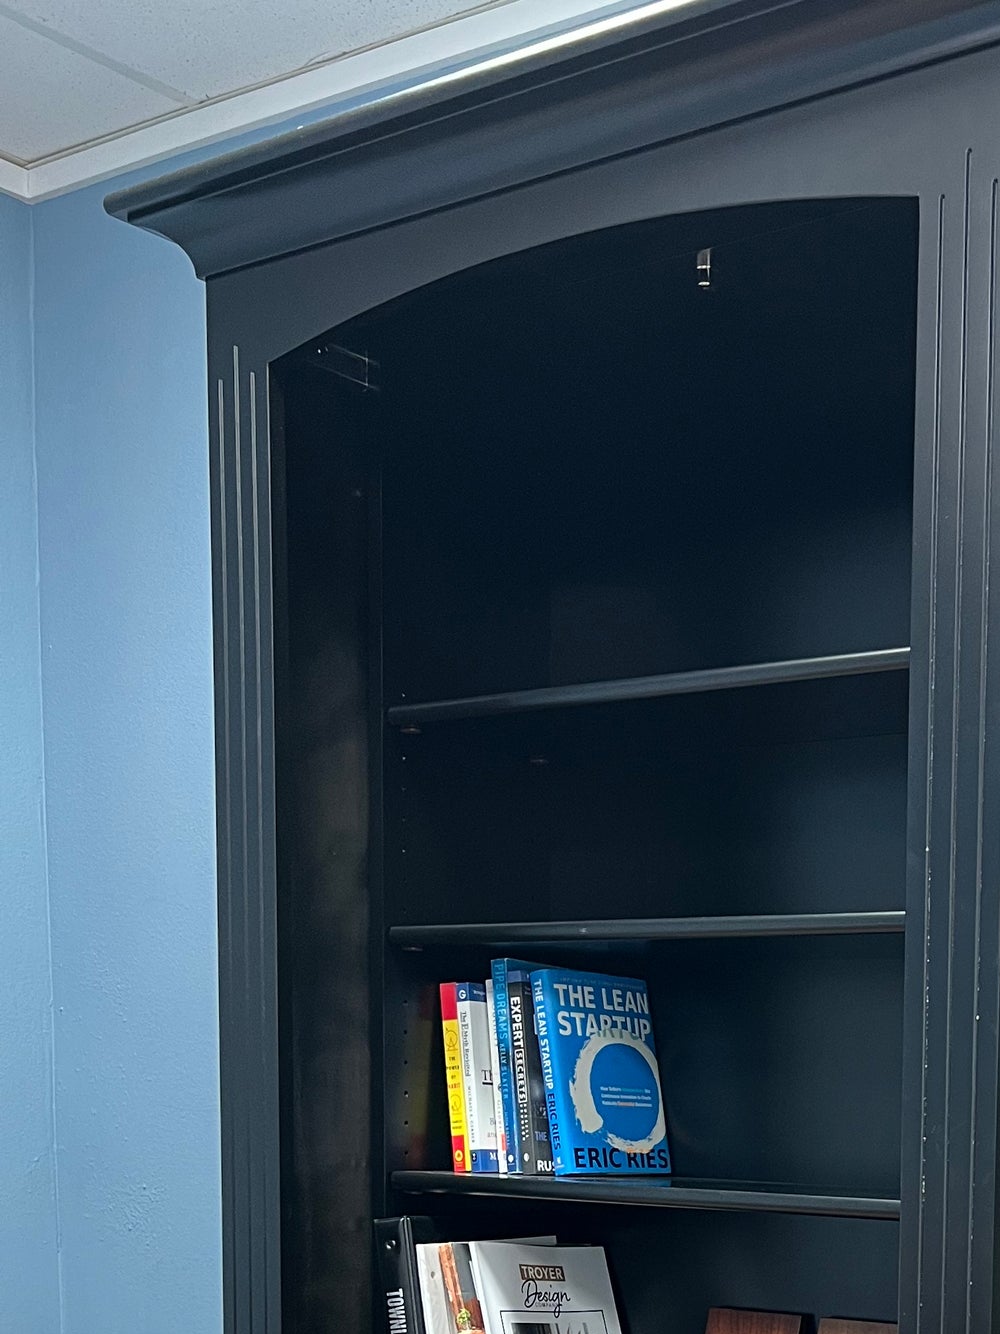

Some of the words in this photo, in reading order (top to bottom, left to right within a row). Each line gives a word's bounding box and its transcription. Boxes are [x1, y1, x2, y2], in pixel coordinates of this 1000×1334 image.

[494, 963, 506, 990] PIPE
[534, 978, 544, 1003] THE
[553, 983, 596, 1009] THE
[601, 987, 649, 1015] LEAN
[496, 992, 508, 1040] DREAMS
[510, 996, 524, 1048] EXPERT
[536, 1005, 548, 1036] LEAN
[557, 1010, 651, 1042] STARTUP
[516, 1050, 527, 1102] SECRETS
[540, 1038, 554, 1090] STARTUP
[500, 1066, 510, 1099] SLATER
[547, 1093, 557, 1121] ERIC
[535, 1131, 548, 1142] THE
[551, 1123, 562, 1151] RIES
[573, 1147, 622, 1168] ERIC
[626, 1147, 668, 1169] RIES
[520, 1265, 564, 1280] TROYER
[521, 1278, 571, 1318] Design
